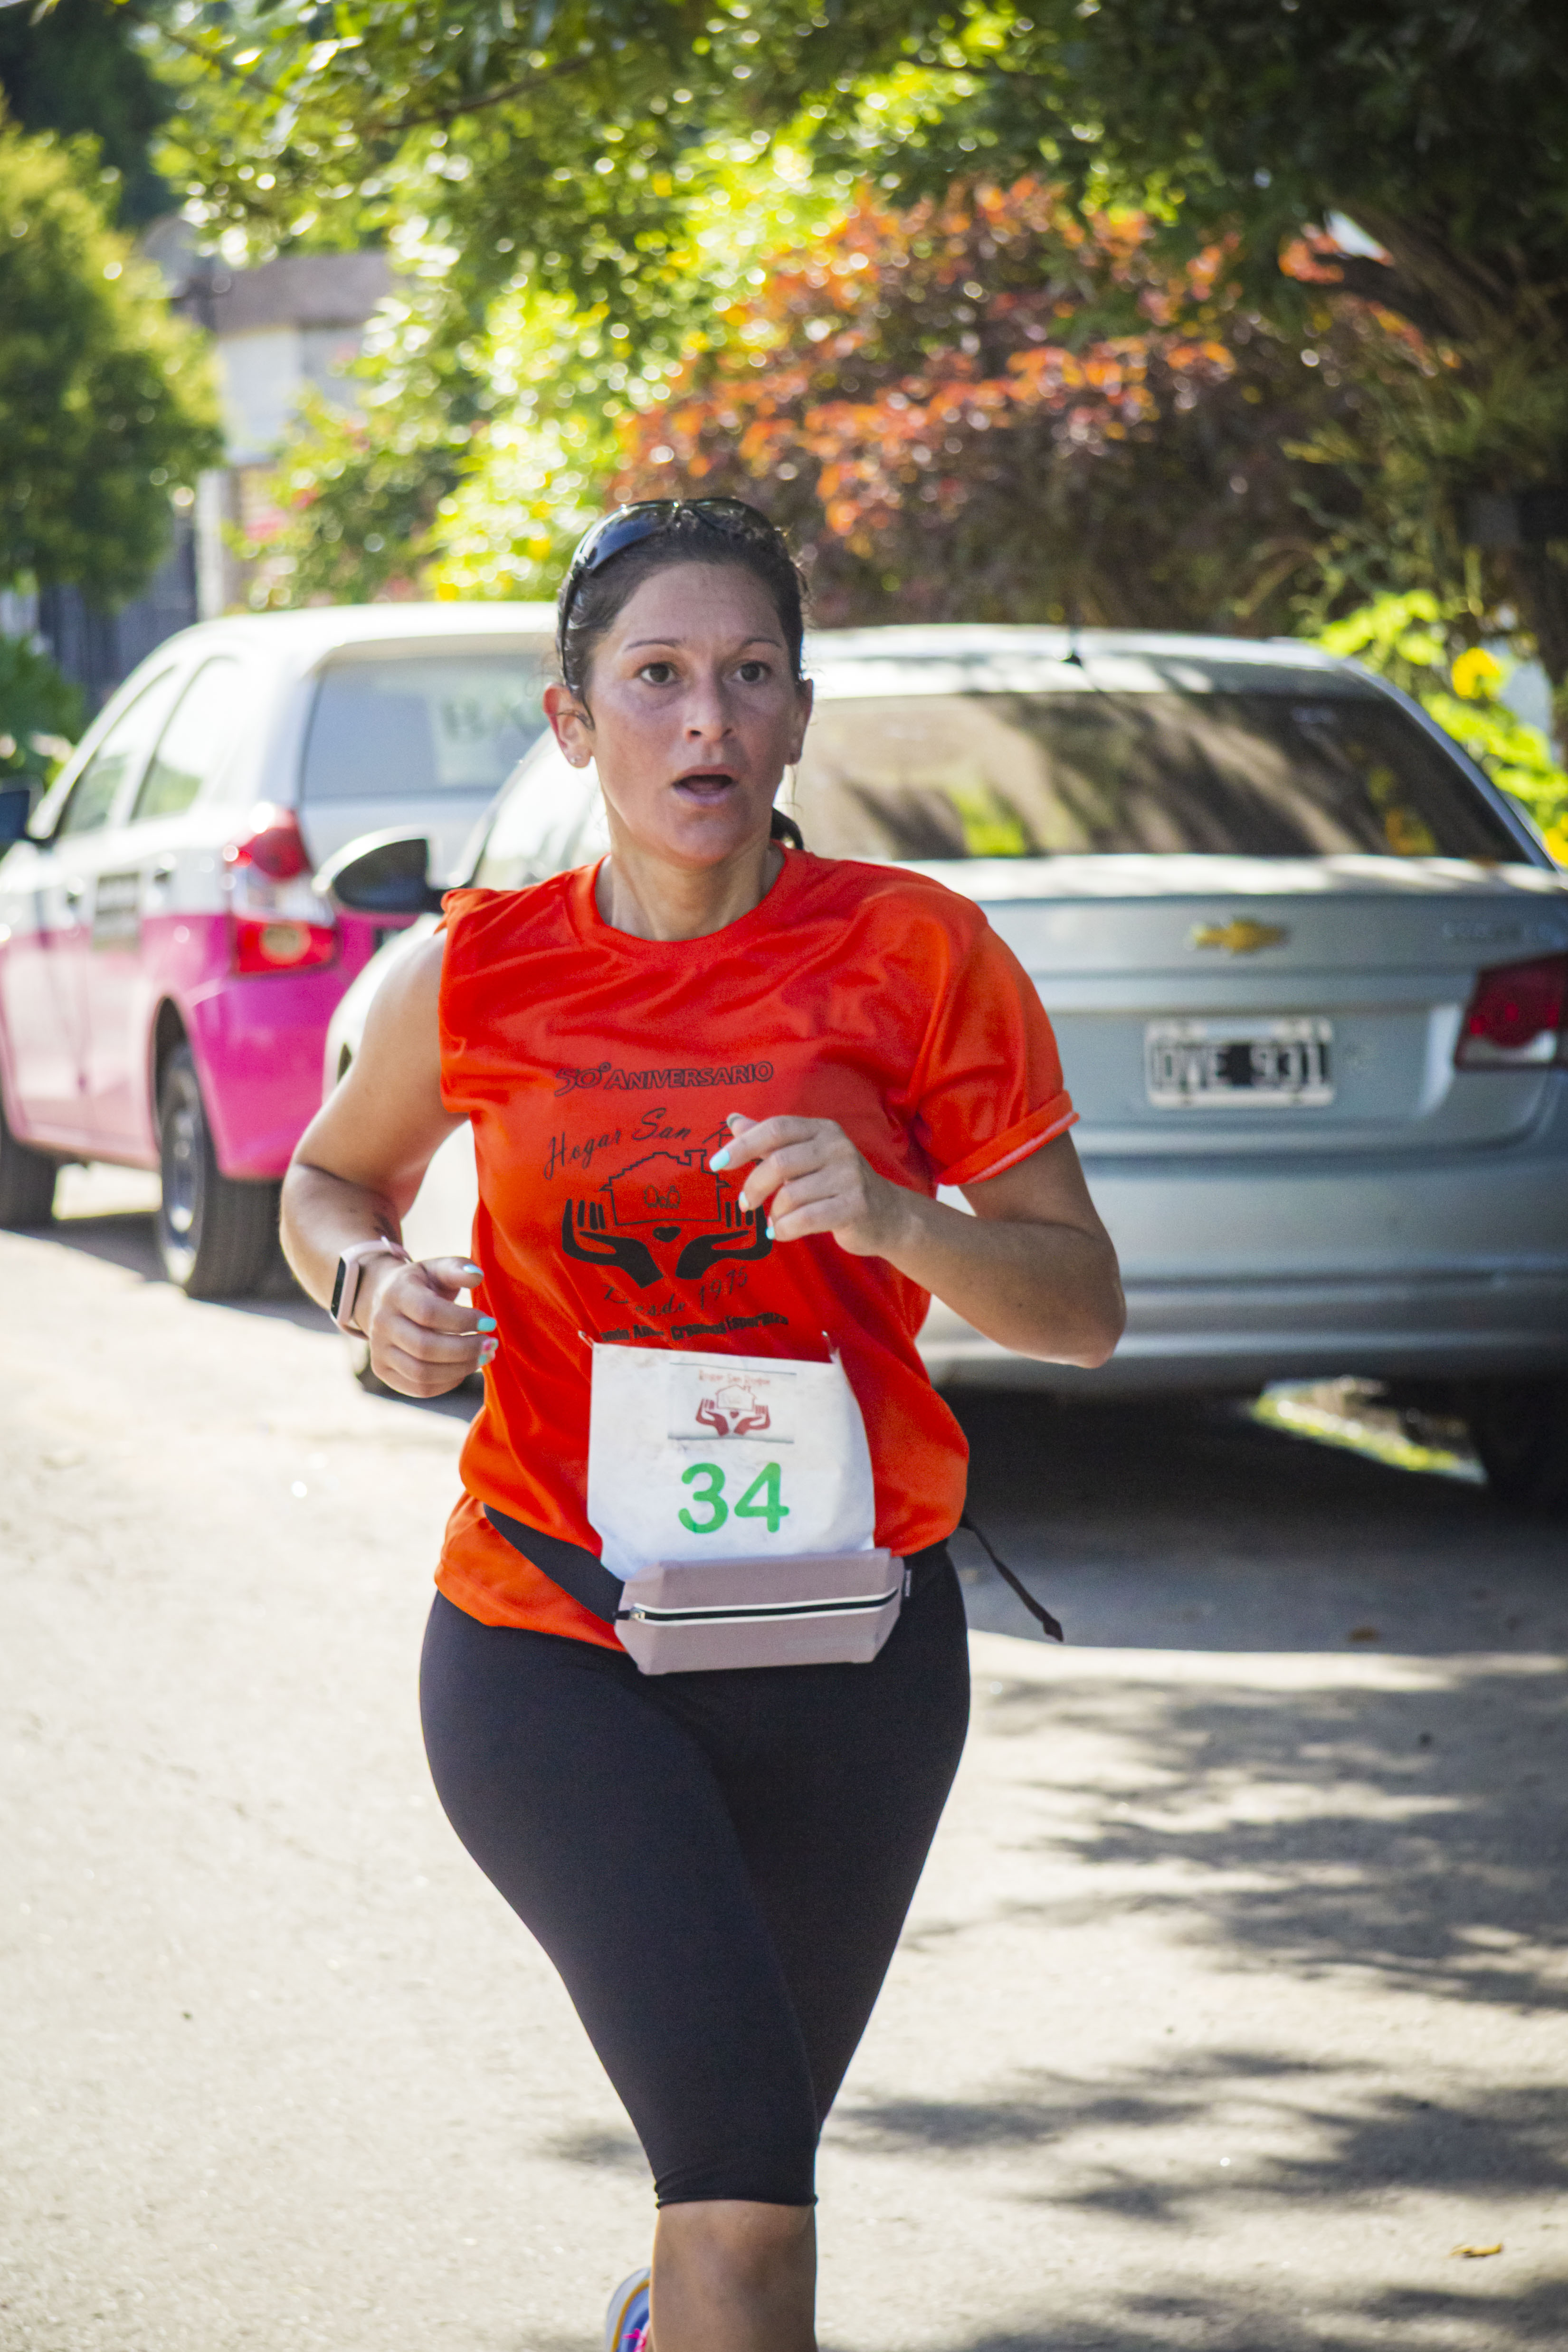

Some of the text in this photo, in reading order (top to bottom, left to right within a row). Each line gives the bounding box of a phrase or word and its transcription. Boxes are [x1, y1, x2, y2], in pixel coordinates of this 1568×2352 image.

[603, 1061, 773, 1090] ANIVERSARIO
[543, 1131, 621, 1181] Hogar
[632, 1107, 691, 1141] San
[678, 1462, 790, 1533] 34
